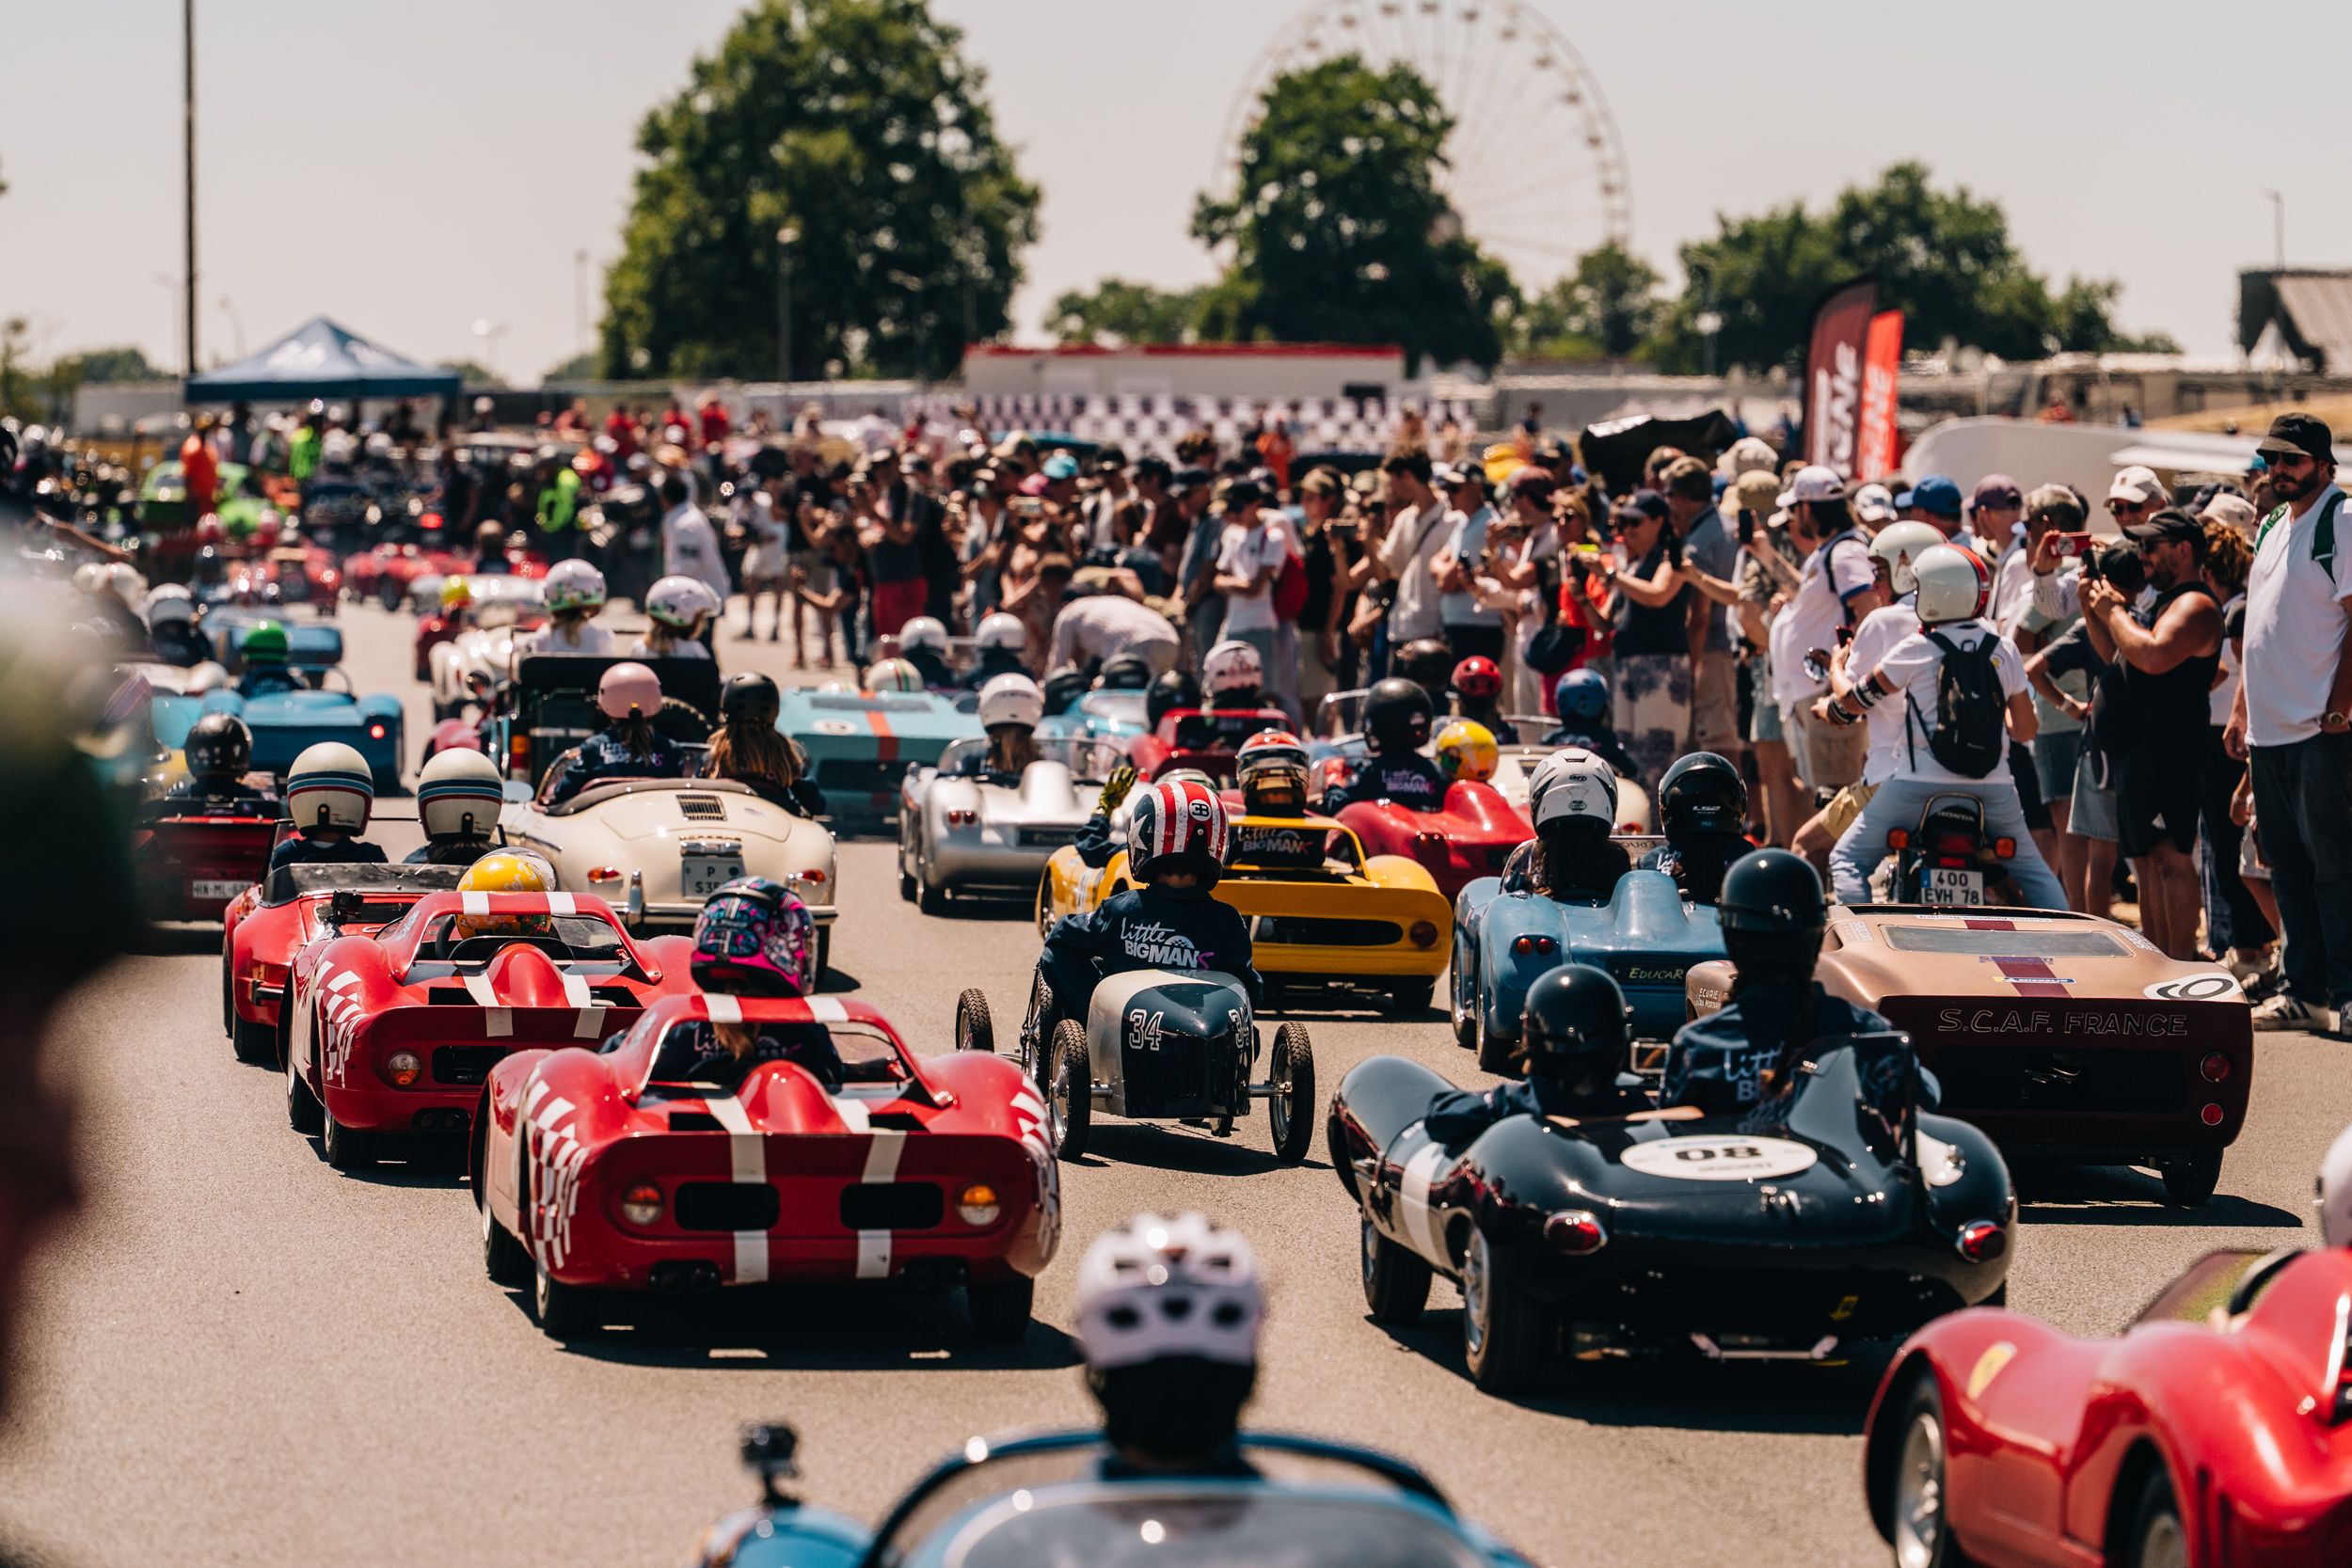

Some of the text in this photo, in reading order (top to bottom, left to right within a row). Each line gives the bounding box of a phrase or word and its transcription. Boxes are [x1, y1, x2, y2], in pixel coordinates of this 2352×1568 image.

[1938, 811, 1975, 822] HONDA
[707, 866, 716, 877] P
[1936, 872, 1968, 886] 400
[1925, 888, 1979, 905] EVH 78
[1120, 917, 1176, 943] Little
[1124, 939, 1215, 971] BIGMANS
[1629, 967, 1684, 980] EDUCAR
[1698, 988, 1719, 1000] ECURIE
[1129, 1008, 1165, 1052] 34
[1938, 1008, 2188, 1037] S.C.A.F. FRANCE
